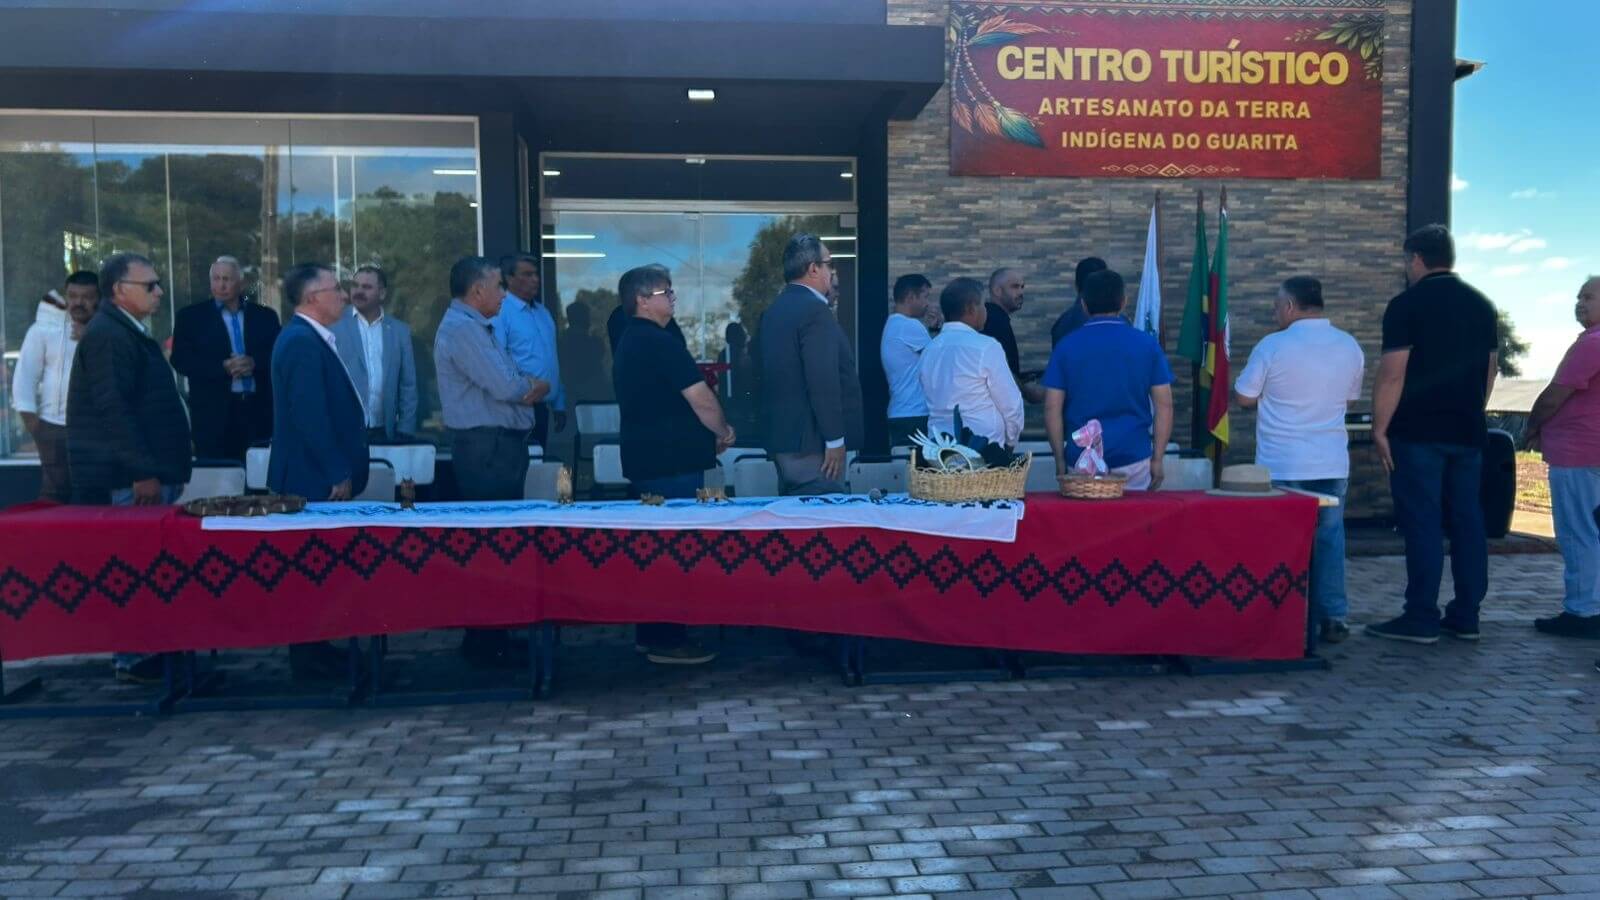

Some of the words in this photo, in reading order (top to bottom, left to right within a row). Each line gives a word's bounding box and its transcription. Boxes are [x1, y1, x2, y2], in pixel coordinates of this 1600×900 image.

[997, 45, 1152, 82] CENTRO
[1160, 38, 1349, 85] TURÍSTICO
[1038, 97, 1194, 117] ARTESANATO
[1200, 99, 1229, 118] DA
[1236, 99, 1311, 119] TERRA
[1061, 128, 1166, 149] INDÍGENA
[1172, 132, 1201, 149] DO
[1206, 133, 1298, 150] GUARITA
